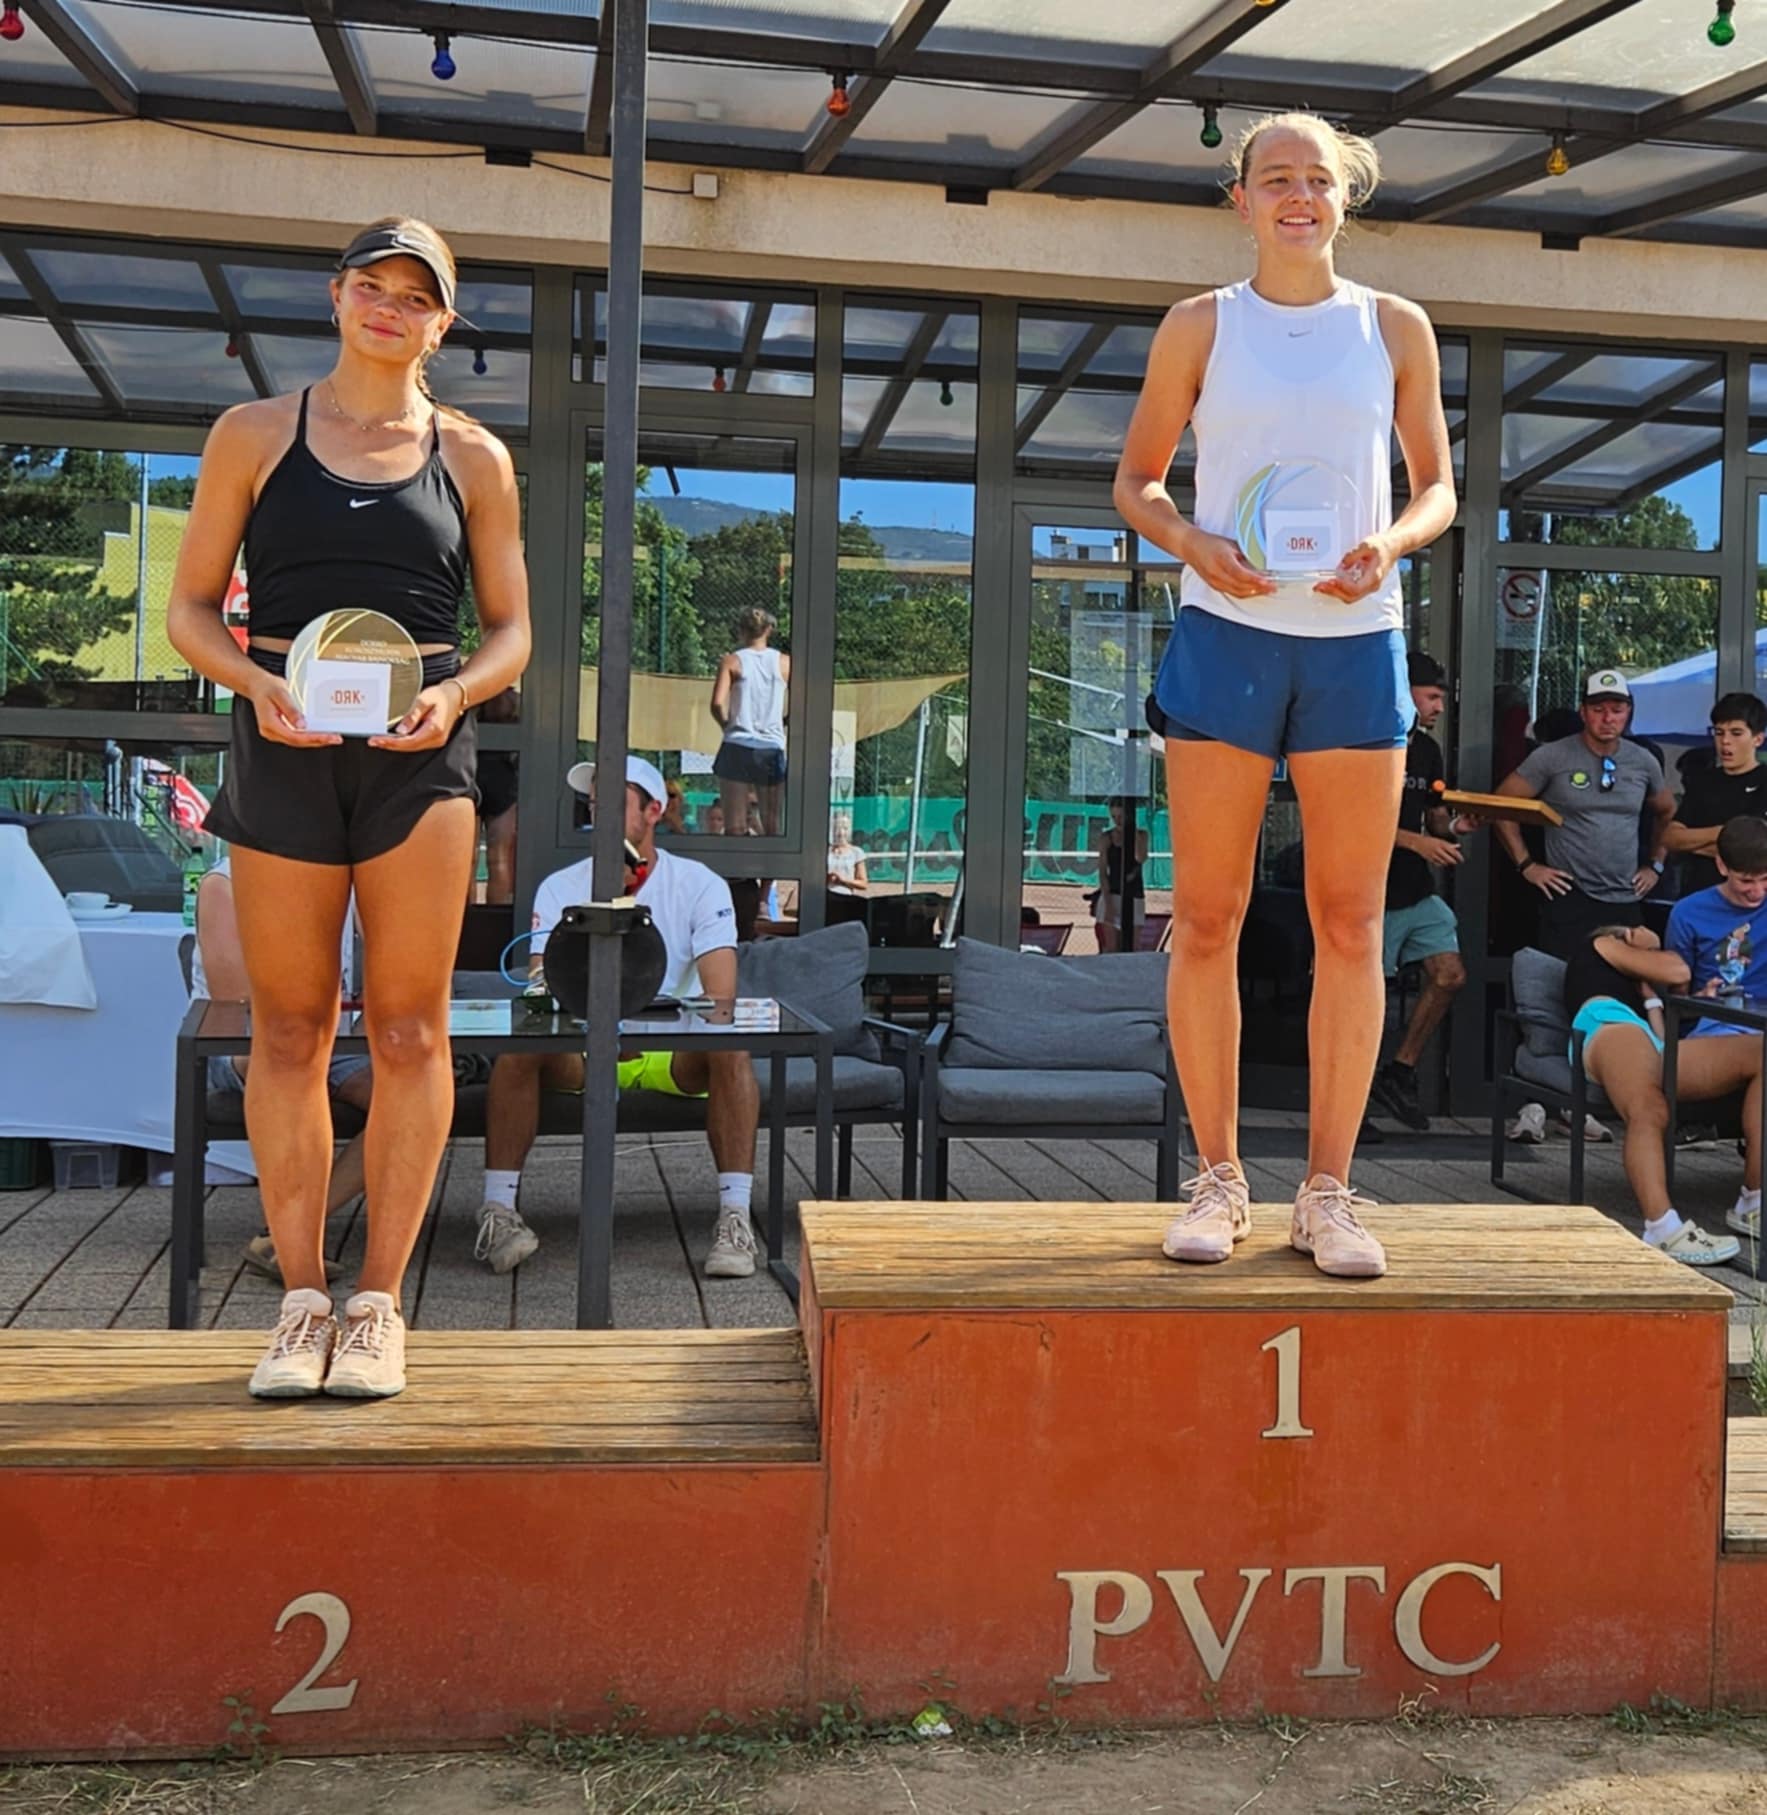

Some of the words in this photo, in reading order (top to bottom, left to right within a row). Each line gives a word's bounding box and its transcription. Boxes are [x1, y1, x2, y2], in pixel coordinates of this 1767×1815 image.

[1260, 1326, 1314, 1440] 1
[271, 1591, 359, 1715] 2
[1054, 1562, 1502, 1686] PVTC
